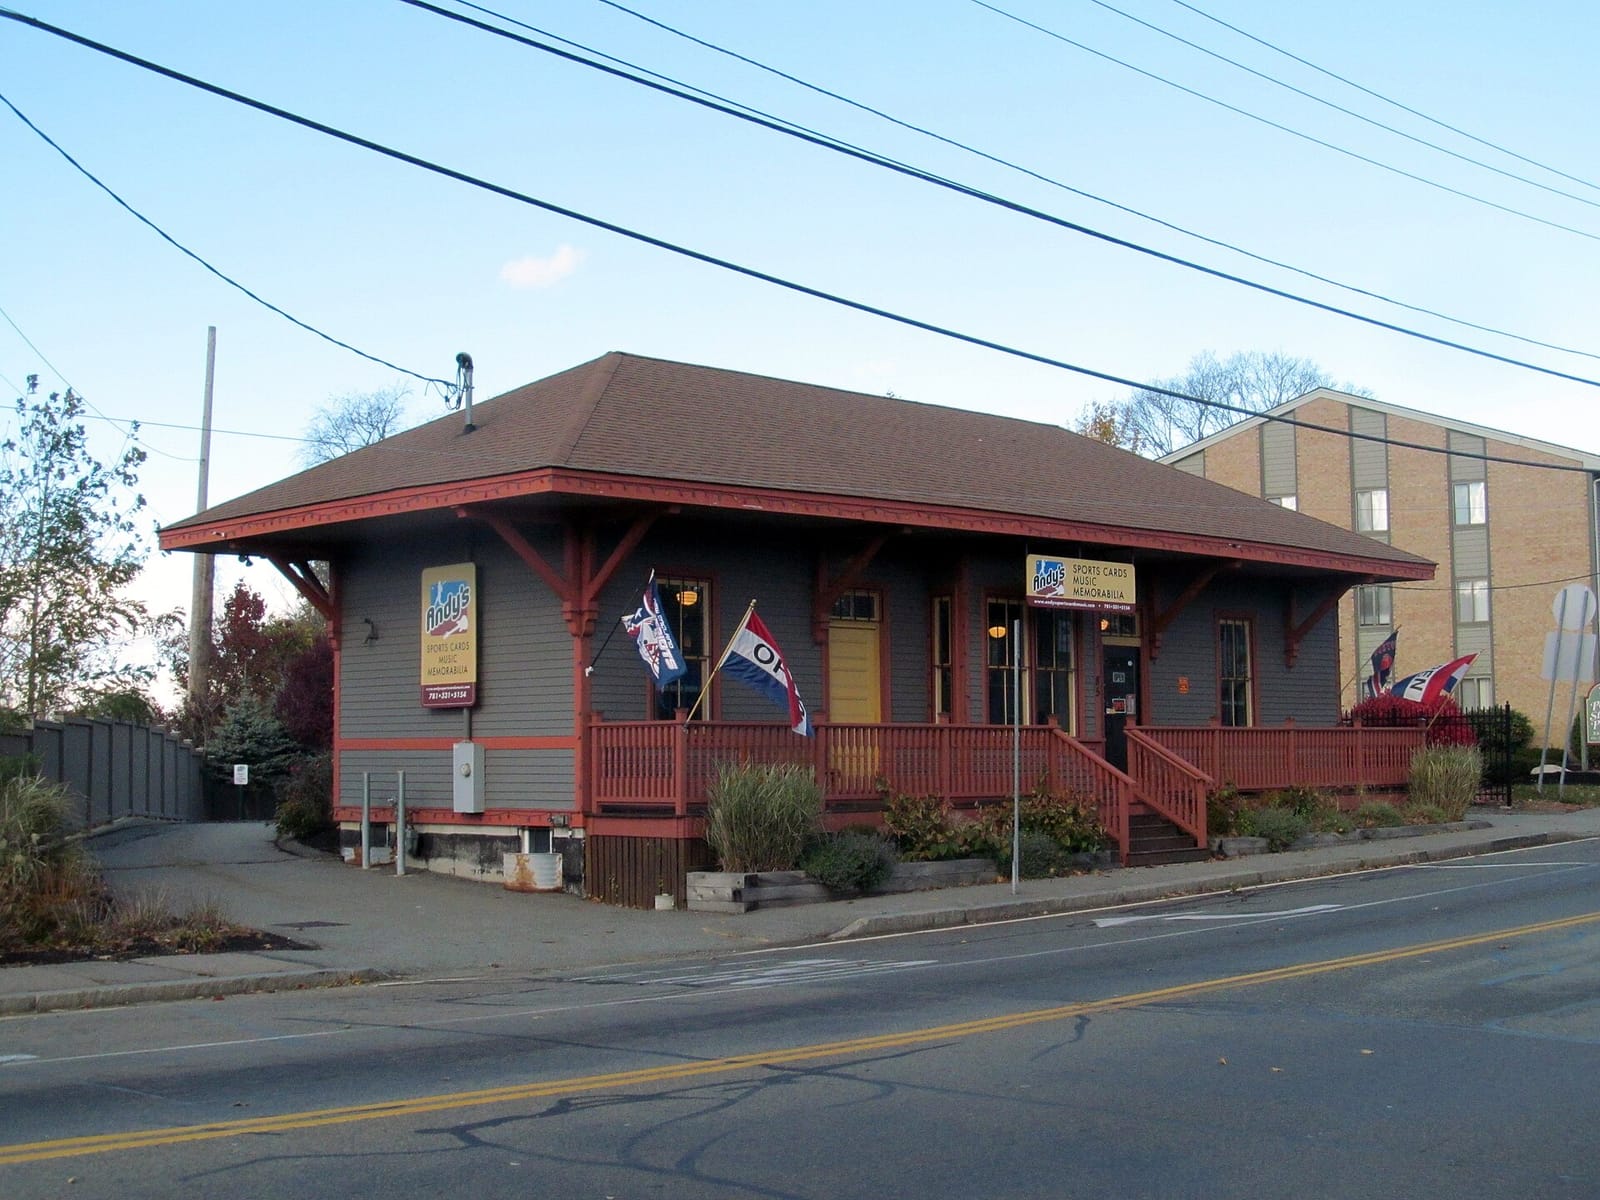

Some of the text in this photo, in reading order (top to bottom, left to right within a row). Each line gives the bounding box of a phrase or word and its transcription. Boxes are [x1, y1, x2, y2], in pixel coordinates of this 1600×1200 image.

[1072, 564, 1128, 578] SPORTS CARDS
[1033, 565, 1065, 592] Andy's
[1072, 577, 1097, 587] MUSIC
[1073, 588, 1124, 599] MEMORABILIA
[426, 585, 470, 632] Andy's
[427, 641, 470, 653] SPORTS CARDS
[439, 655, 457, 663] MUSIC
[427, 665, 468, 676] MEMORABILIA
